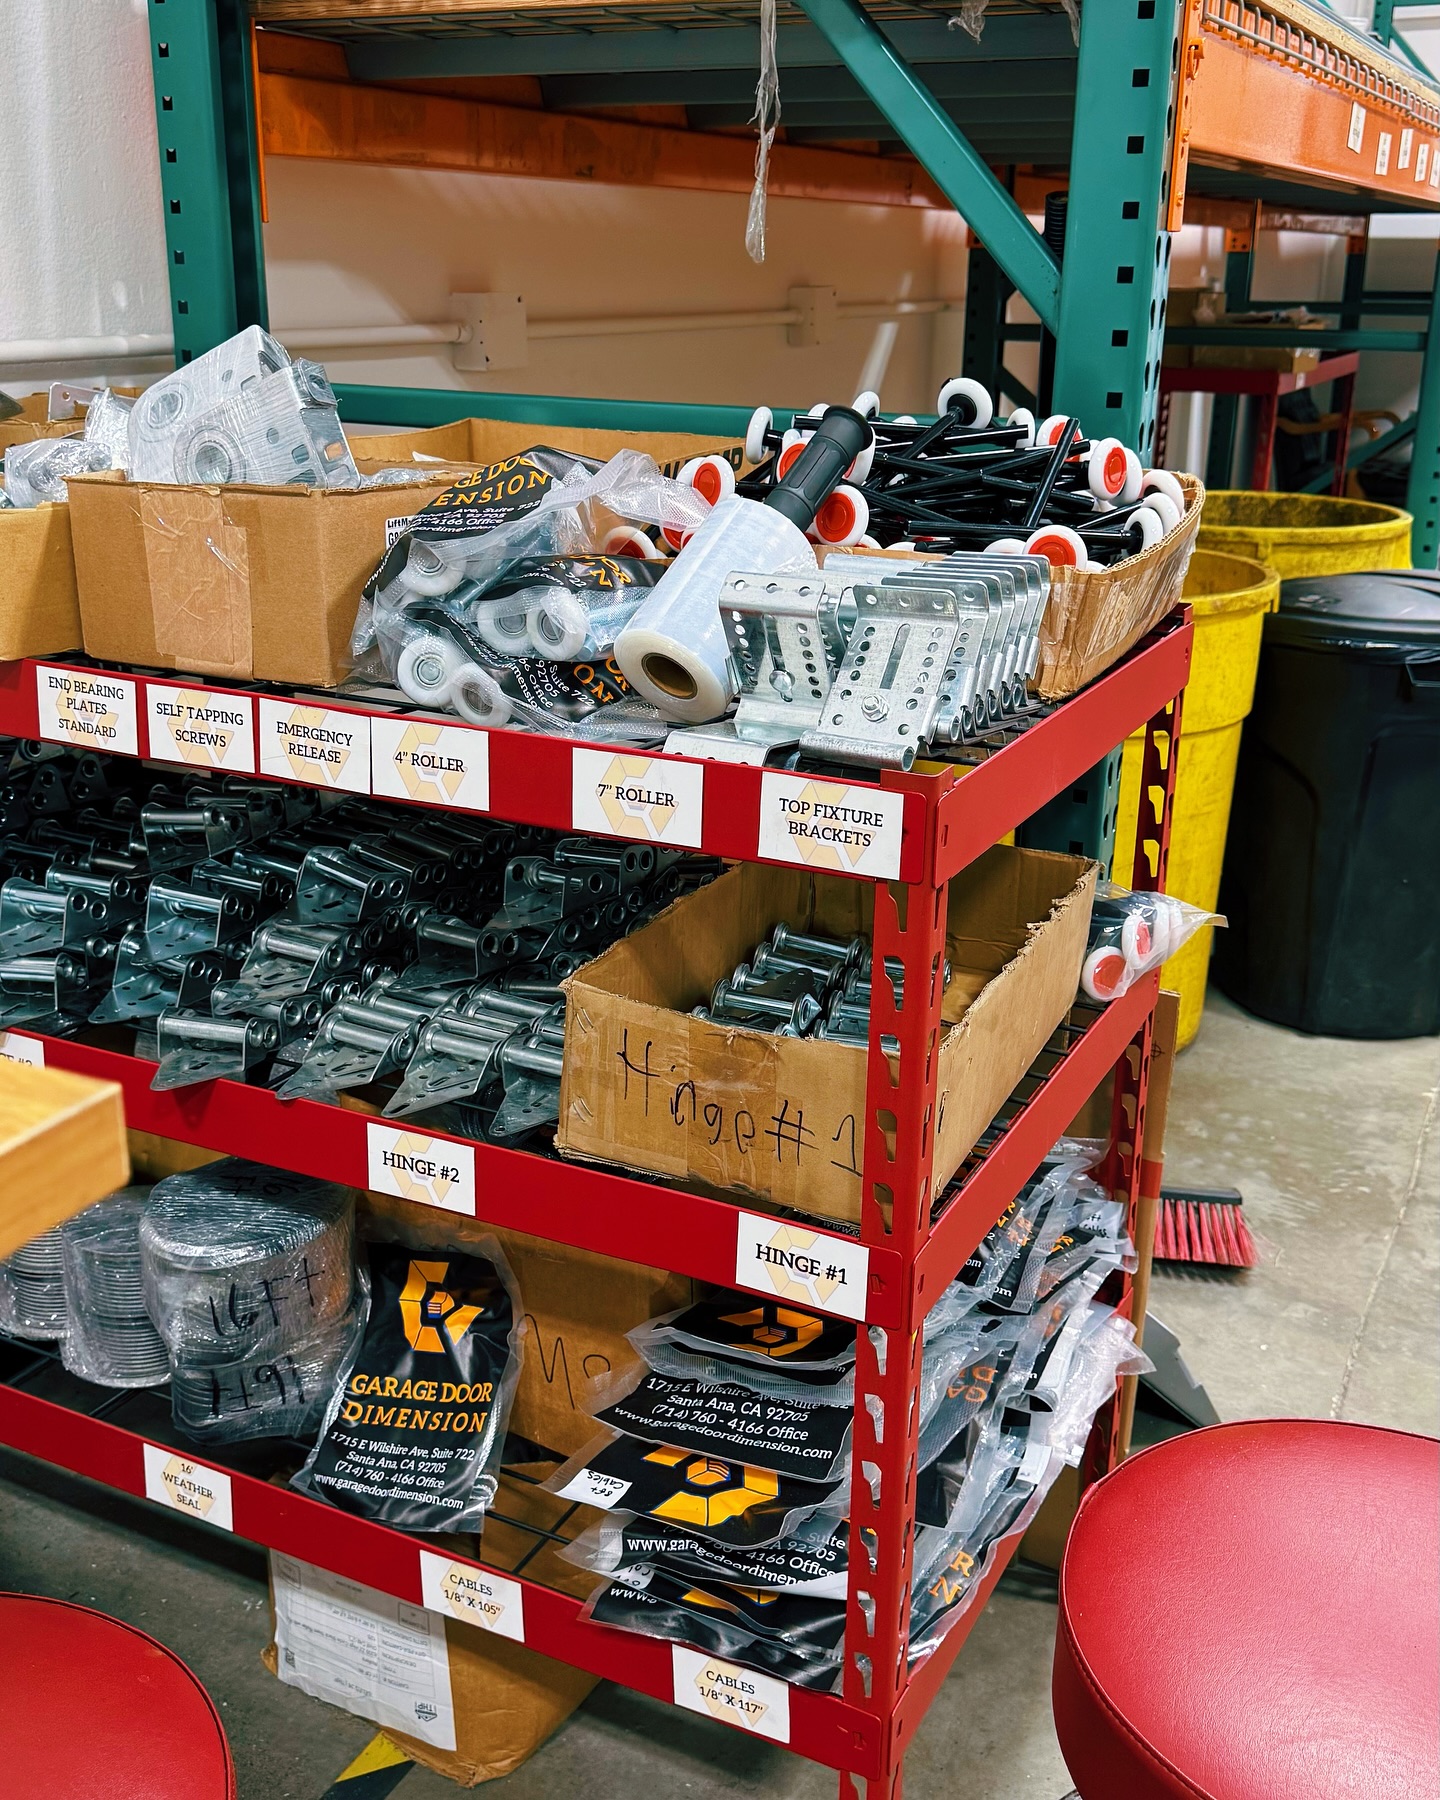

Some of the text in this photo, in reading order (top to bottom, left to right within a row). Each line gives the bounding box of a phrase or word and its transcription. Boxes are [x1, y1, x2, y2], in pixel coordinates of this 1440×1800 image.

[432, 470, 550, 507] ENSION
[48, 675, 124, 700] END BEARING
[529, 674, 554, 708] Office
[535, 660, 560, 698] 92705
[549, 664, 595, 706] Suite 722
[65, 697, 108, 715] PLATES
[156, 702, 244, 727] SELF TAPPING
[58, 717, 117, 740] STANDARD
[174, 728, 227, 748] SCREWS
[276, 721, 353, 747] EMERGENCY
[288, 742, 342, 765] RELEASE
[410, 753, 465, 773] ROLLER
[615, 786, 675, 808] ROLLER
[779, 797, 884, 828] TOP FIXTURE
[788, 820, 872, 847] BRACKETS
[381, 1151, 460, 1184] HINGE #2
[755, 1243, 848, 1285] HINGE #1
[351, 1374, 493, 1403] GARAGE DOOR
[647, 1377, 681, 1393] 1715
[681, 1383, 691, 1393] E
[695, 1382, 750, 1398] Wilshire
[342, 1401, 488, 1433] DIMENSION
[666, 1394, 810, 1422] Santa Ana, CA 92705
[614, 1406, 833, 1459] www.garagedoordimension.com
[651, 1404, 689, 1420] (714)
[692, 1411, 717, 1424] 760
[727, 1419, 763, 1435] 4166
[767, 1426, 809, 1440] Office
[330, 1431, 475, 1461] 1715 E Wilshire Ave, Suite 722
[334, 1459, 363, 1477] (714)
[364, 1467, 384, 1482] 760
[390, 1472, 415, 1485] 4166
[416, 1476, 445, 1489] Office
[346, 1451, 447, 1473] Santa Ana, CA 92705
[163, 1472, 213, 1501] WEATHER
[587, 1470, 625, 1489] Cables
[175, 1492, 201, 1511] SEAL
[746, 1551, 786, 1565] 4166
[787, 1541, 837, 1562] 92705
[449, 1573, 493, 1597] CABLES
[466, 1597, 478, 1609] X
[706, 1670, 755, 1695] CABLES
[725, 1694, 736, 1707] X
